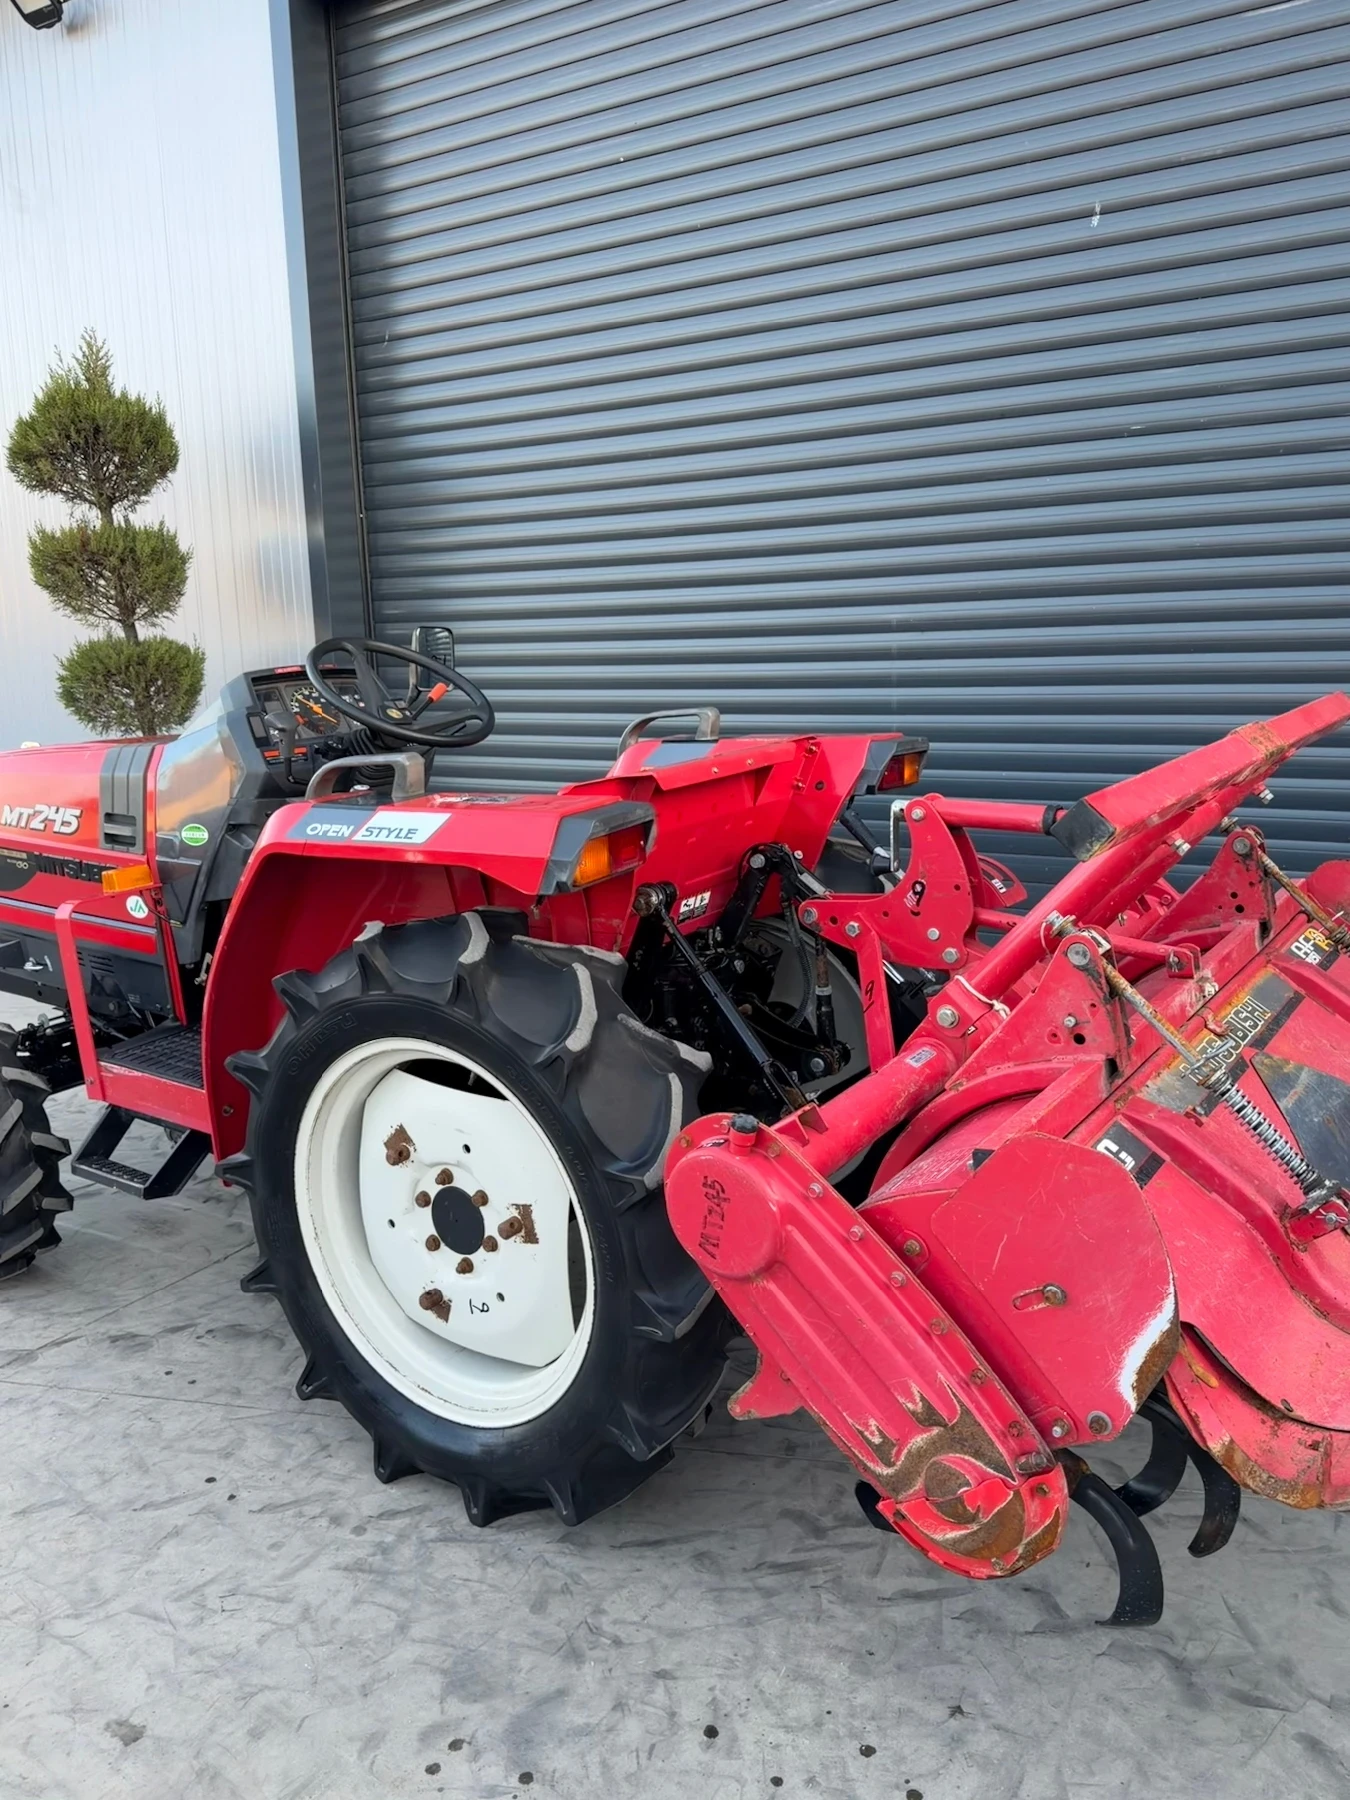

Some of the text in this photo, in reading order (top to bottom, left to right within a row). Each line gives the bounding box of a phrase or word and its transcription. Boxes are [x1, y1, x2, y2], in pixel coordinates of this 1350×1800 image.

[1, 803, 82, 835] MT245
[306, 822, 419, 841] OPEN STYLE
